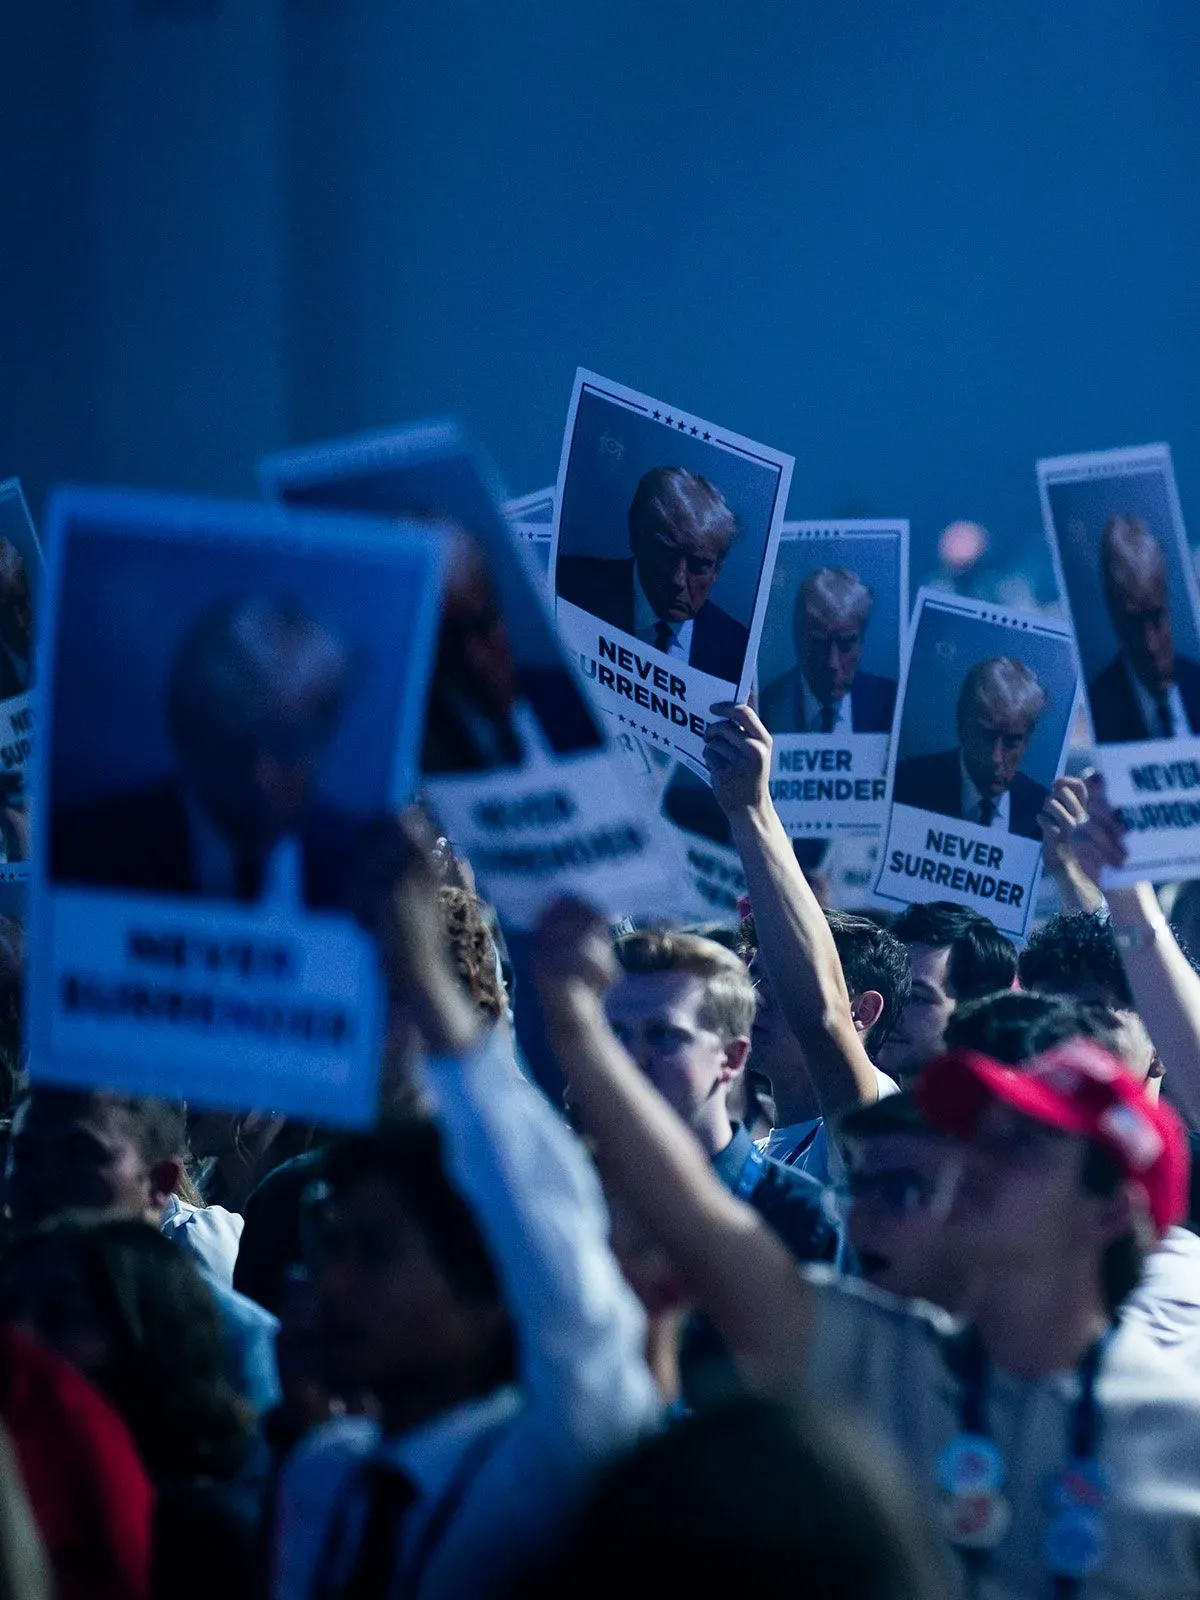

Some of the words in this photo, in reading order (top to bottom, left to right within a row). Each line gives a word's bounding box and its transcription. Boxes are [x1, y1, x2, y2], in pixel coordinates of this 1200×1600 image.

[598, 635, 687, 702] NEVER
[578, 653, 712, 739] URRENDE
[779, 749, 852, 773] NEVER
[769, 779, 887, 801] URRENDER
[926, 828, 1003, 871] NEVER
[889, 850, 1024, 908] SURRENDER
